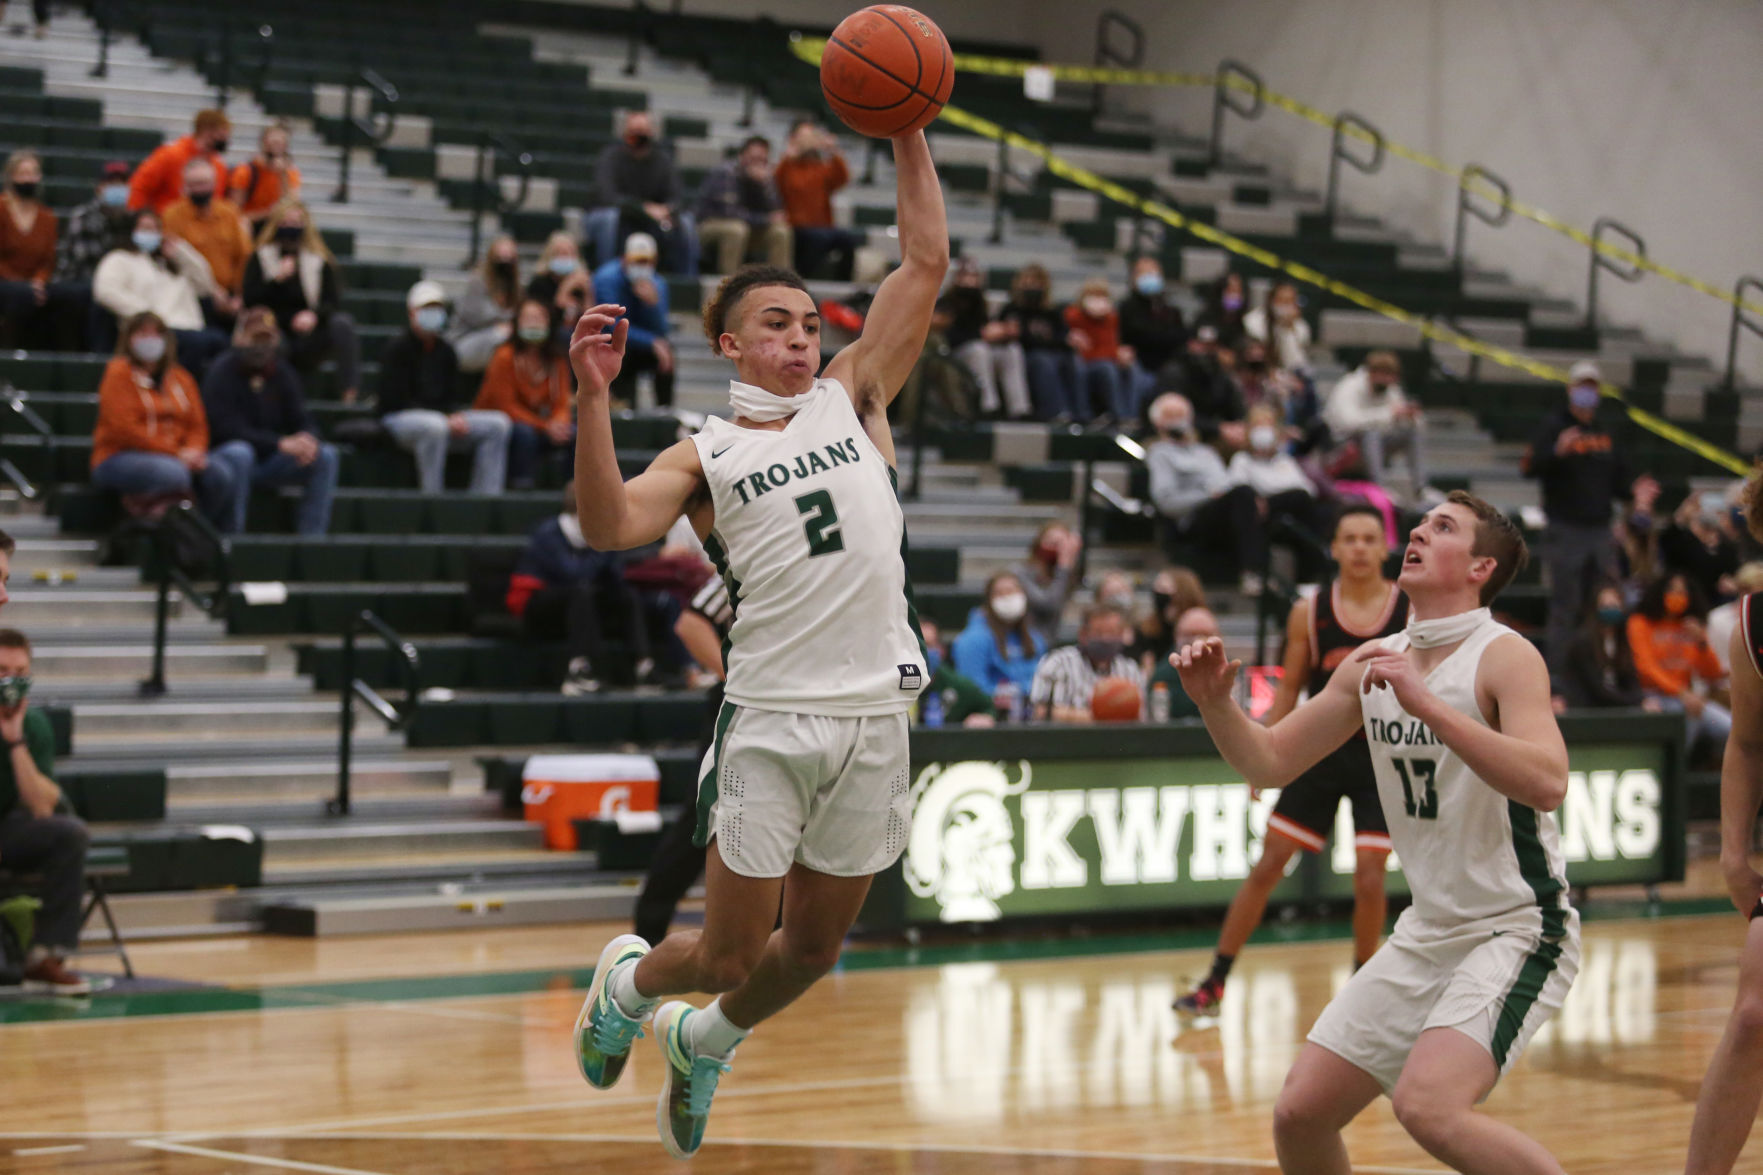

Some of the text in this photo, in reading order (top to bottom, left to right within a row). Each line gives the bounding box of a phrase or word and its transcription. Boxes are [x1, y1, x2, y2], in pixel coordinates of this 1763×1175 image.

[732, 437, 861, 506] TROJANS
[793, 487, 846, 559] 2
[905, 666, 915, 675] M
[1370, 717, 1444, 745] TROJA
[1390, 757, 1438, 820] 13
